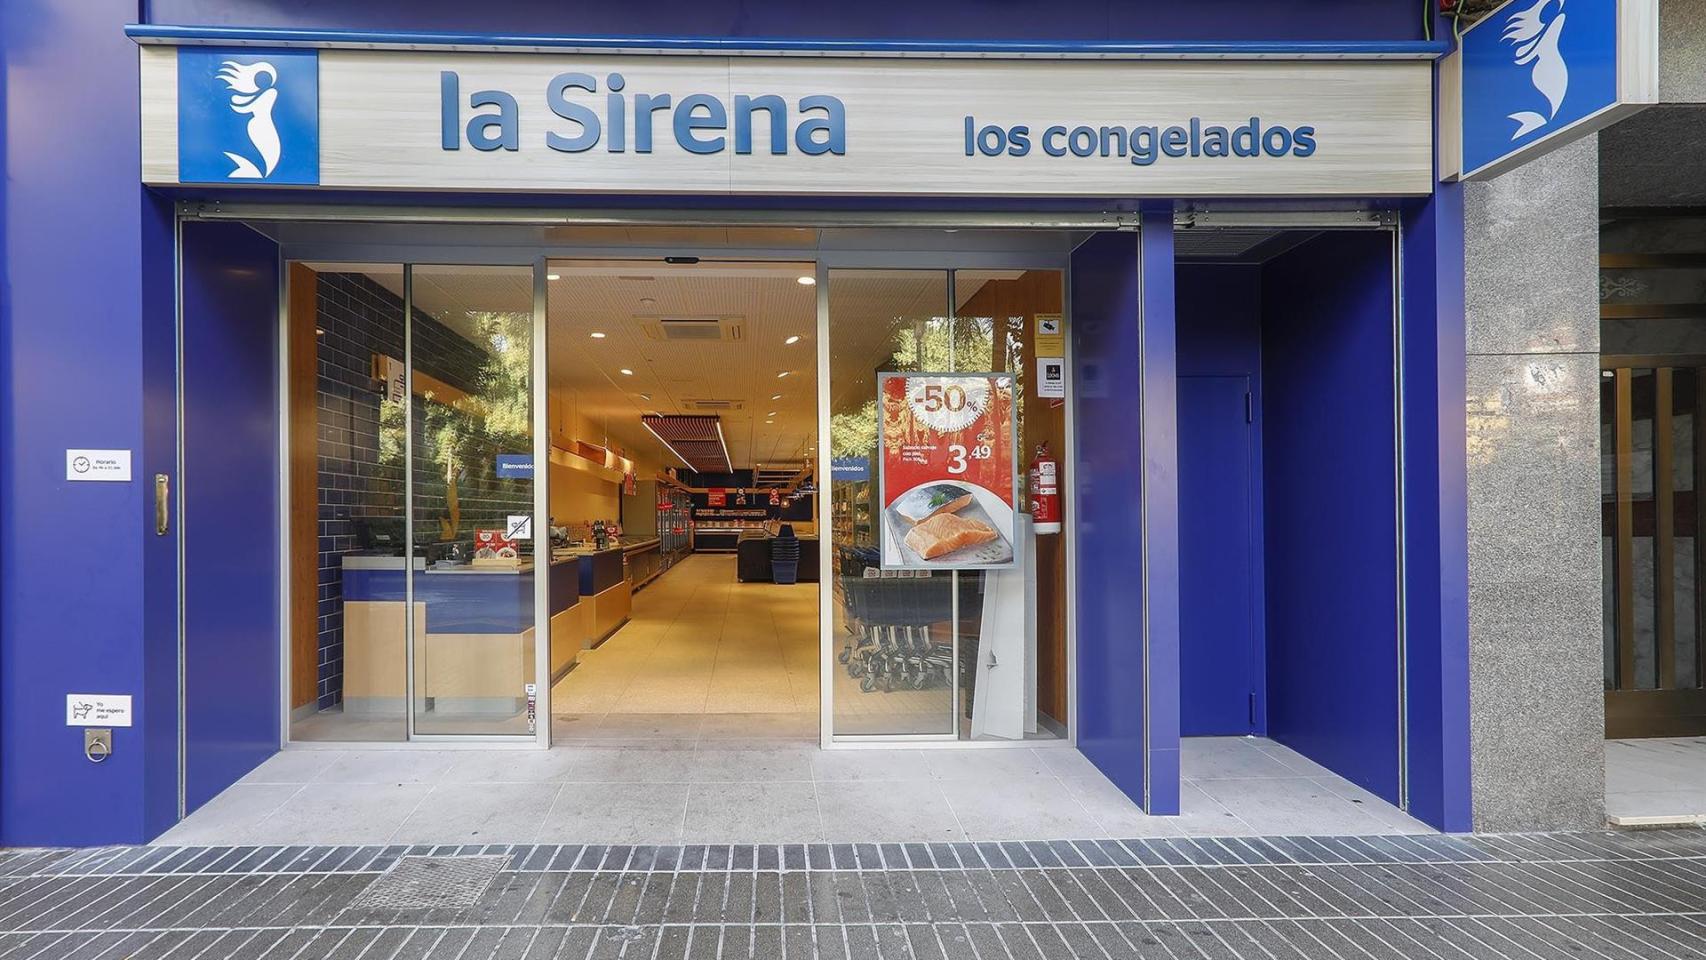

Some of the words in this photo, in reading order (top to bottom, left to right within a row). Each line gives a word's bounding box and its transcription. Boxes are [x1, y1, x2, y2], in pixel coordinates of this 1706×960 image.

[441, 70, 519, 151] la
[545, 71, 847, 155] Sirena
[964, 115, 1032, 157] los
[1041, 116, 1317, 166] congelados
